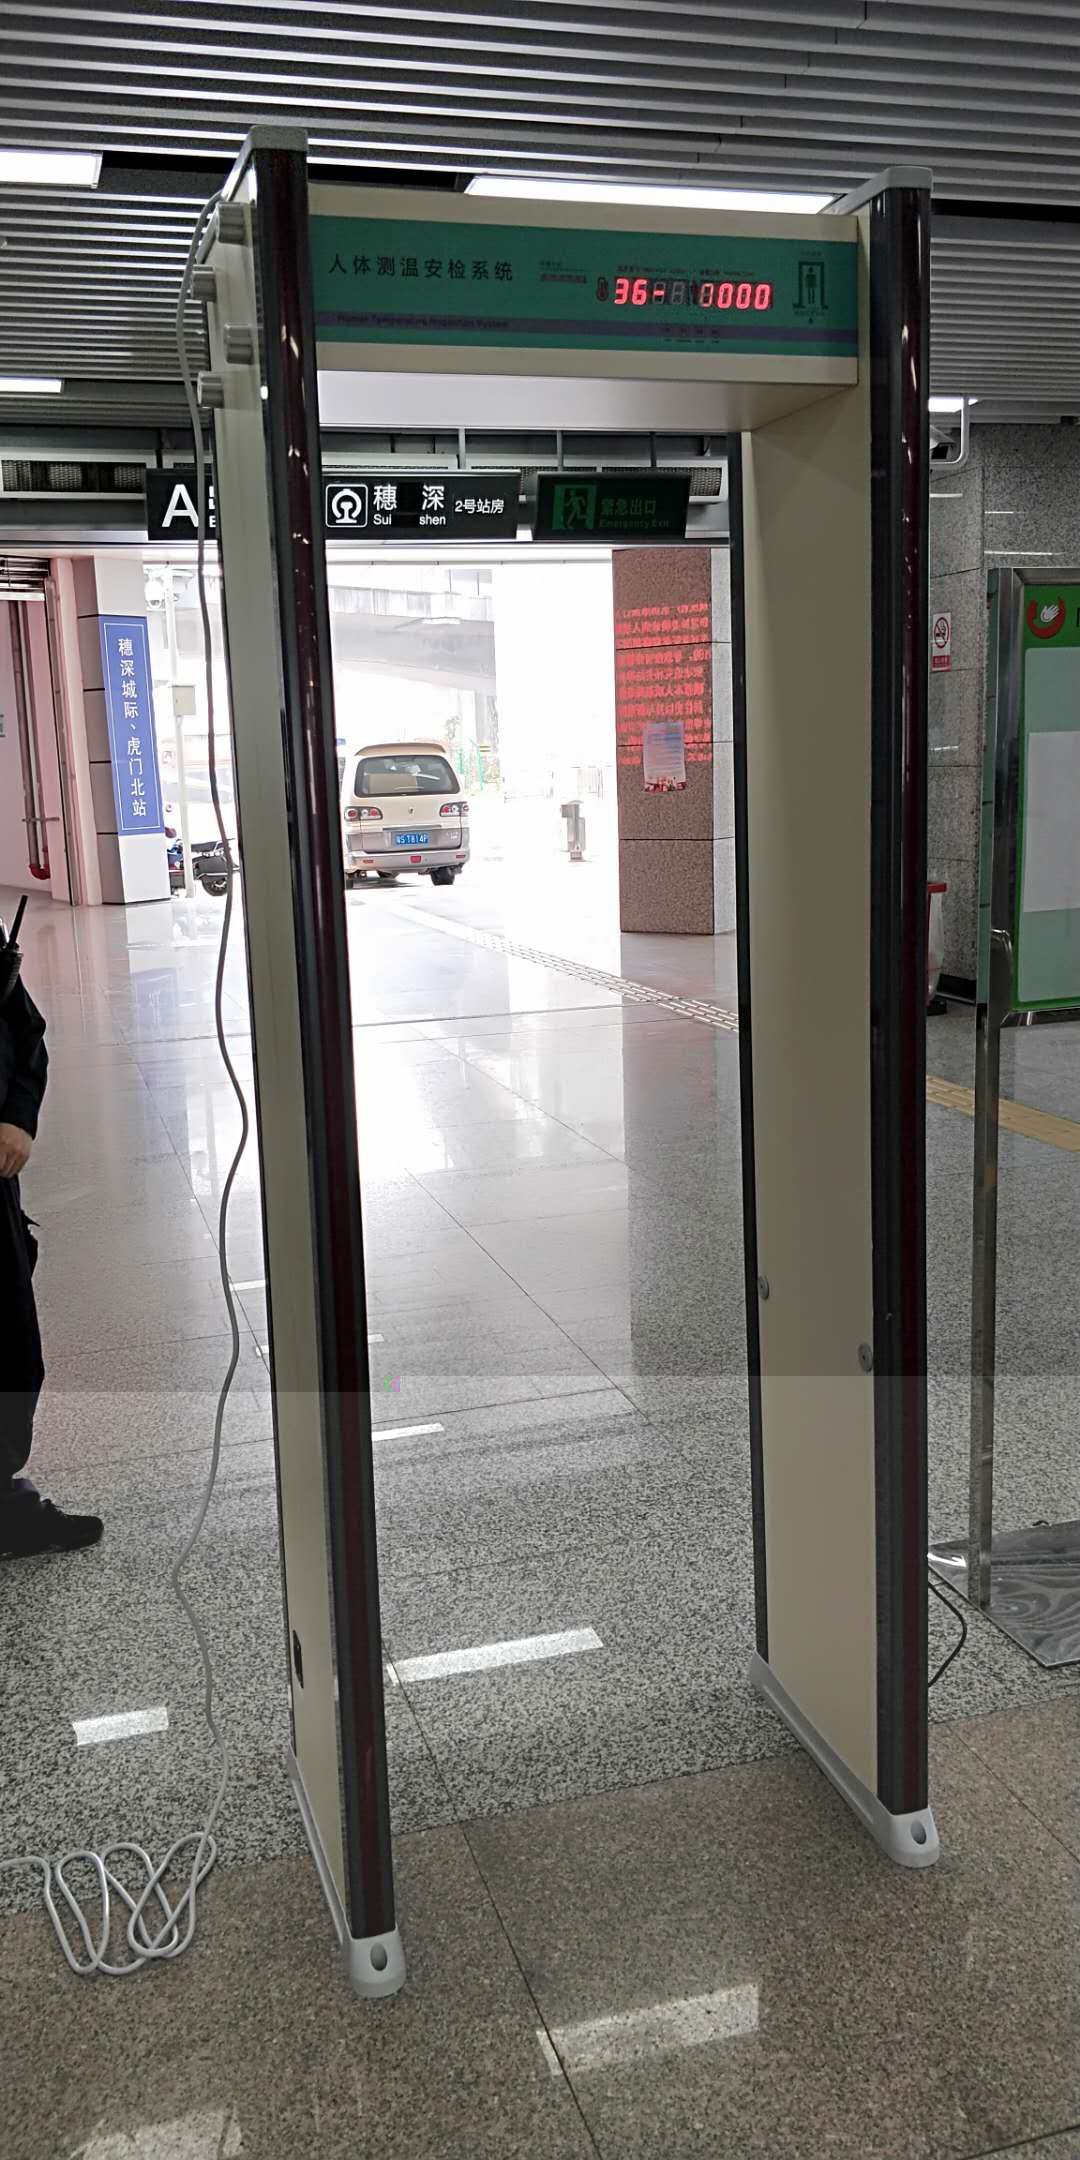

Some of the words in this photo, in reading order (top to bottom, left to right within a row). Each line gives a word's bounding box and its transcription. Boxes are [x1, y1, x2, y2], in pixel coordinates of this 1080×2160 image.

[328, 253, 513, 281] 人体测温安检系统
[161, 483, 199, 528] A
[421, 485, 445, 511] 深
[454, 499, 505, 514] 2号站房
[419, 514, 446, 526] shen
[118, 638, 147, 817] 穗深城际、虎门北站
